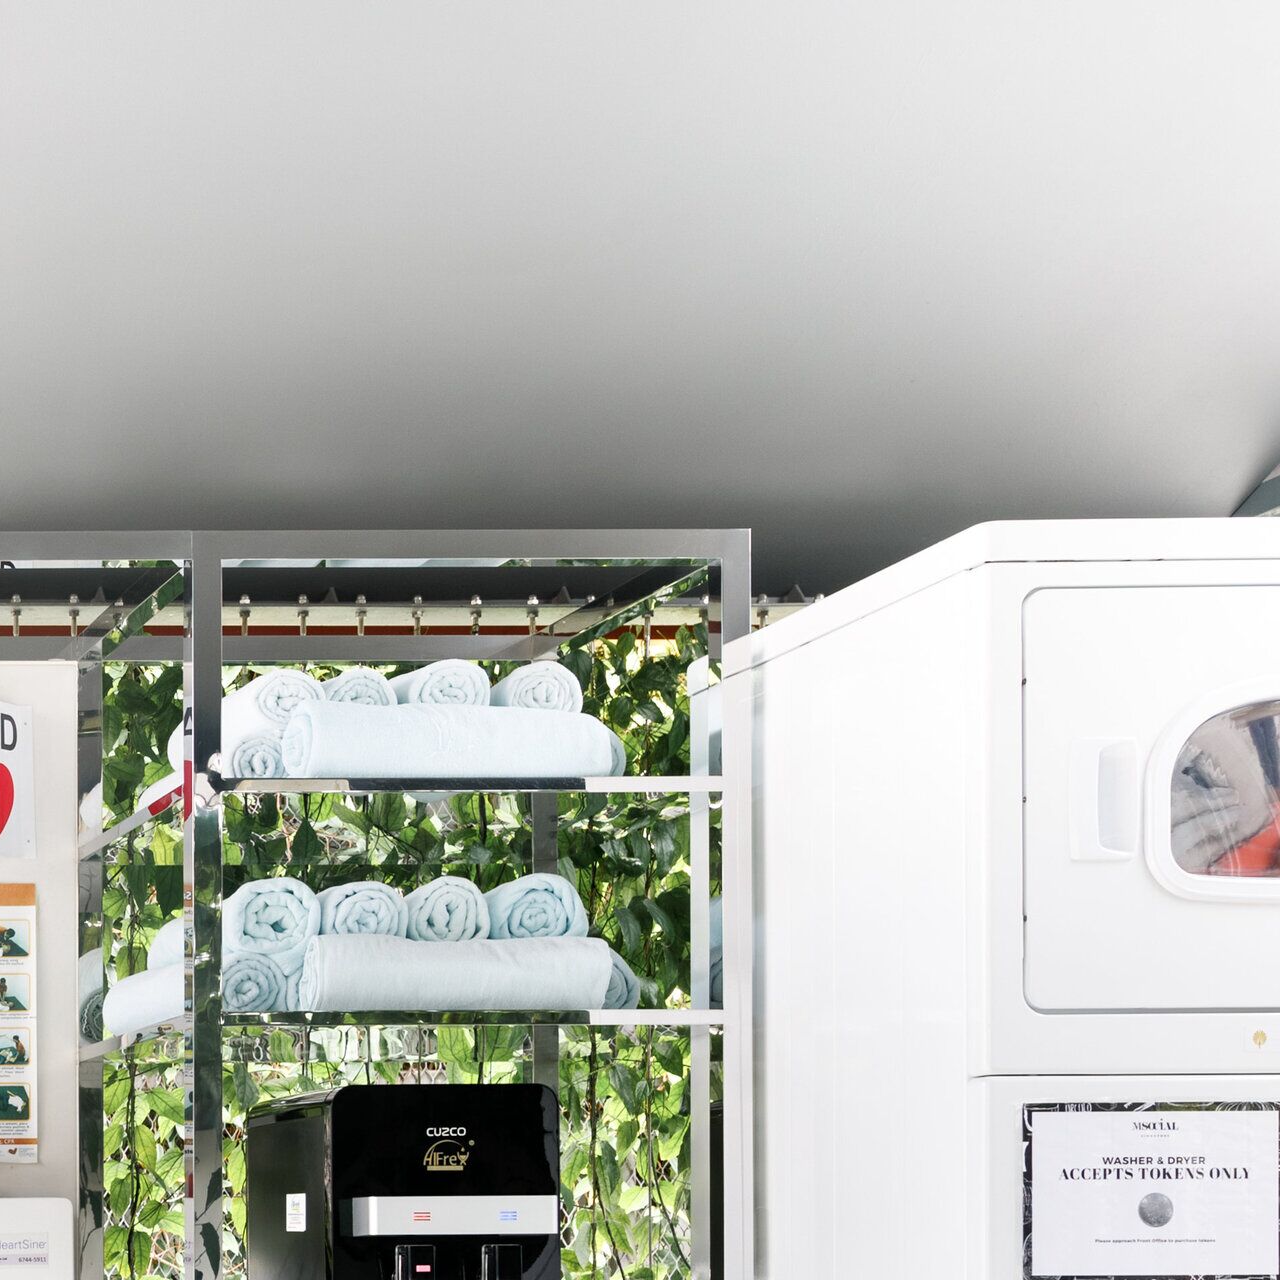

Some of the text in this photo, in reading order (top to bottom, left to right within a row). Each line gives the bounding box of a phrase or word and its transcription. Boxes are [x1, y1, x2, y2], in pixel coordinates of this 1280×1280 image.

[426, 1127, 466, 1137] CUZCO
[1102, 1156, 1206, 1165] WASHER & DRYER
[1059, 1168, 1250, 1180] ACCEPTS TOKENS ONLY
